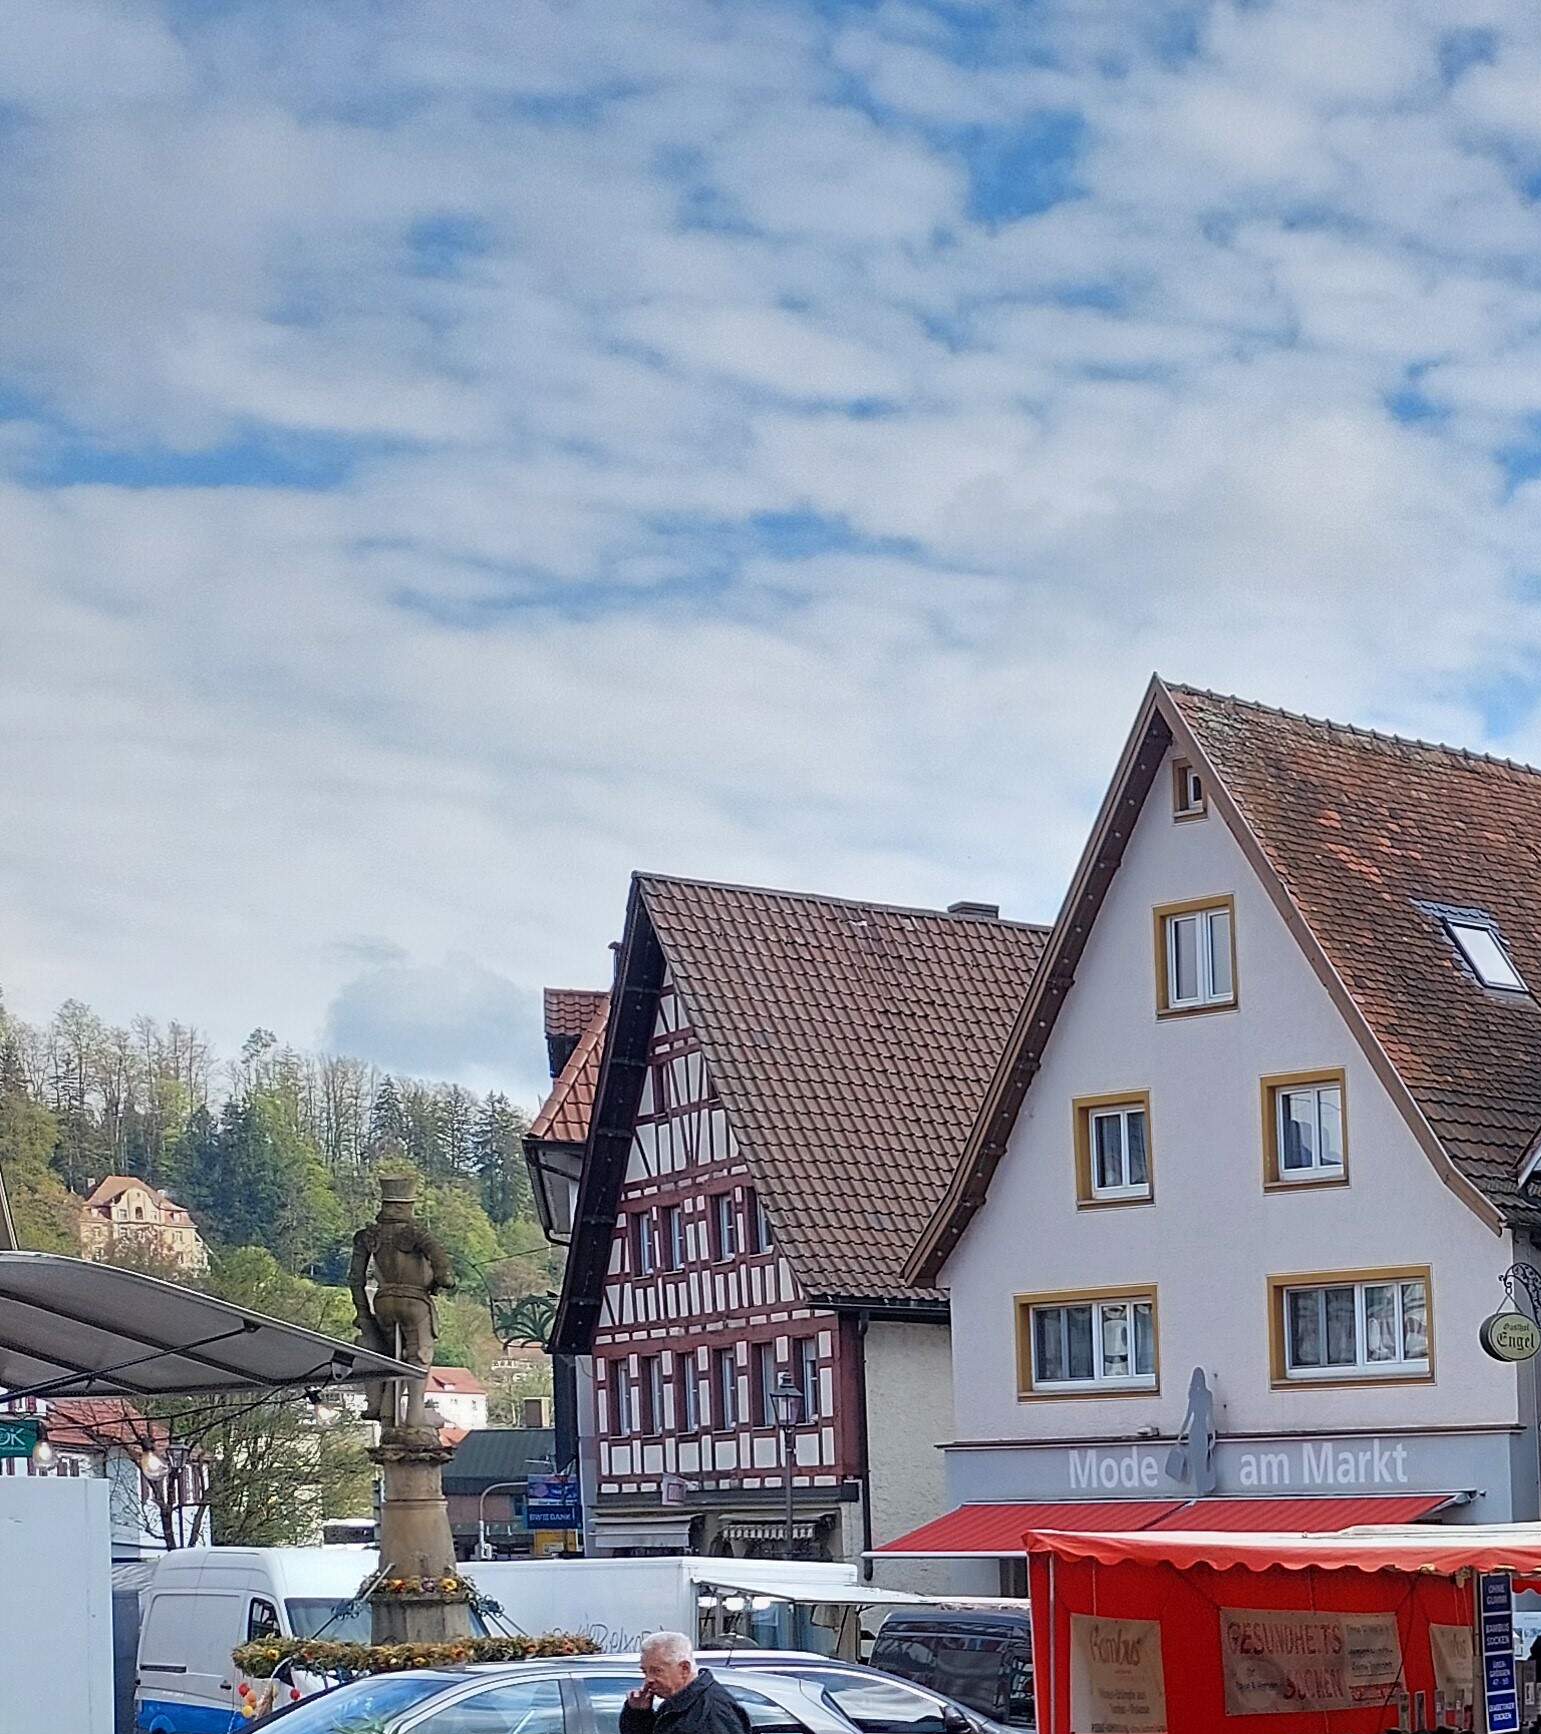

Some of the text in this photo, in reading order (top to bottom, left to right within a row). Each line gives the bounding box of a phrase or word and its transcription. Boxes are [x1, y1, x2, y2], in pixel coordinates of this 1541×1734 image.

[1496, 1331, 1535, 1350] Engel
[1068, 1438, 1408, 1488] Mode am Markt
